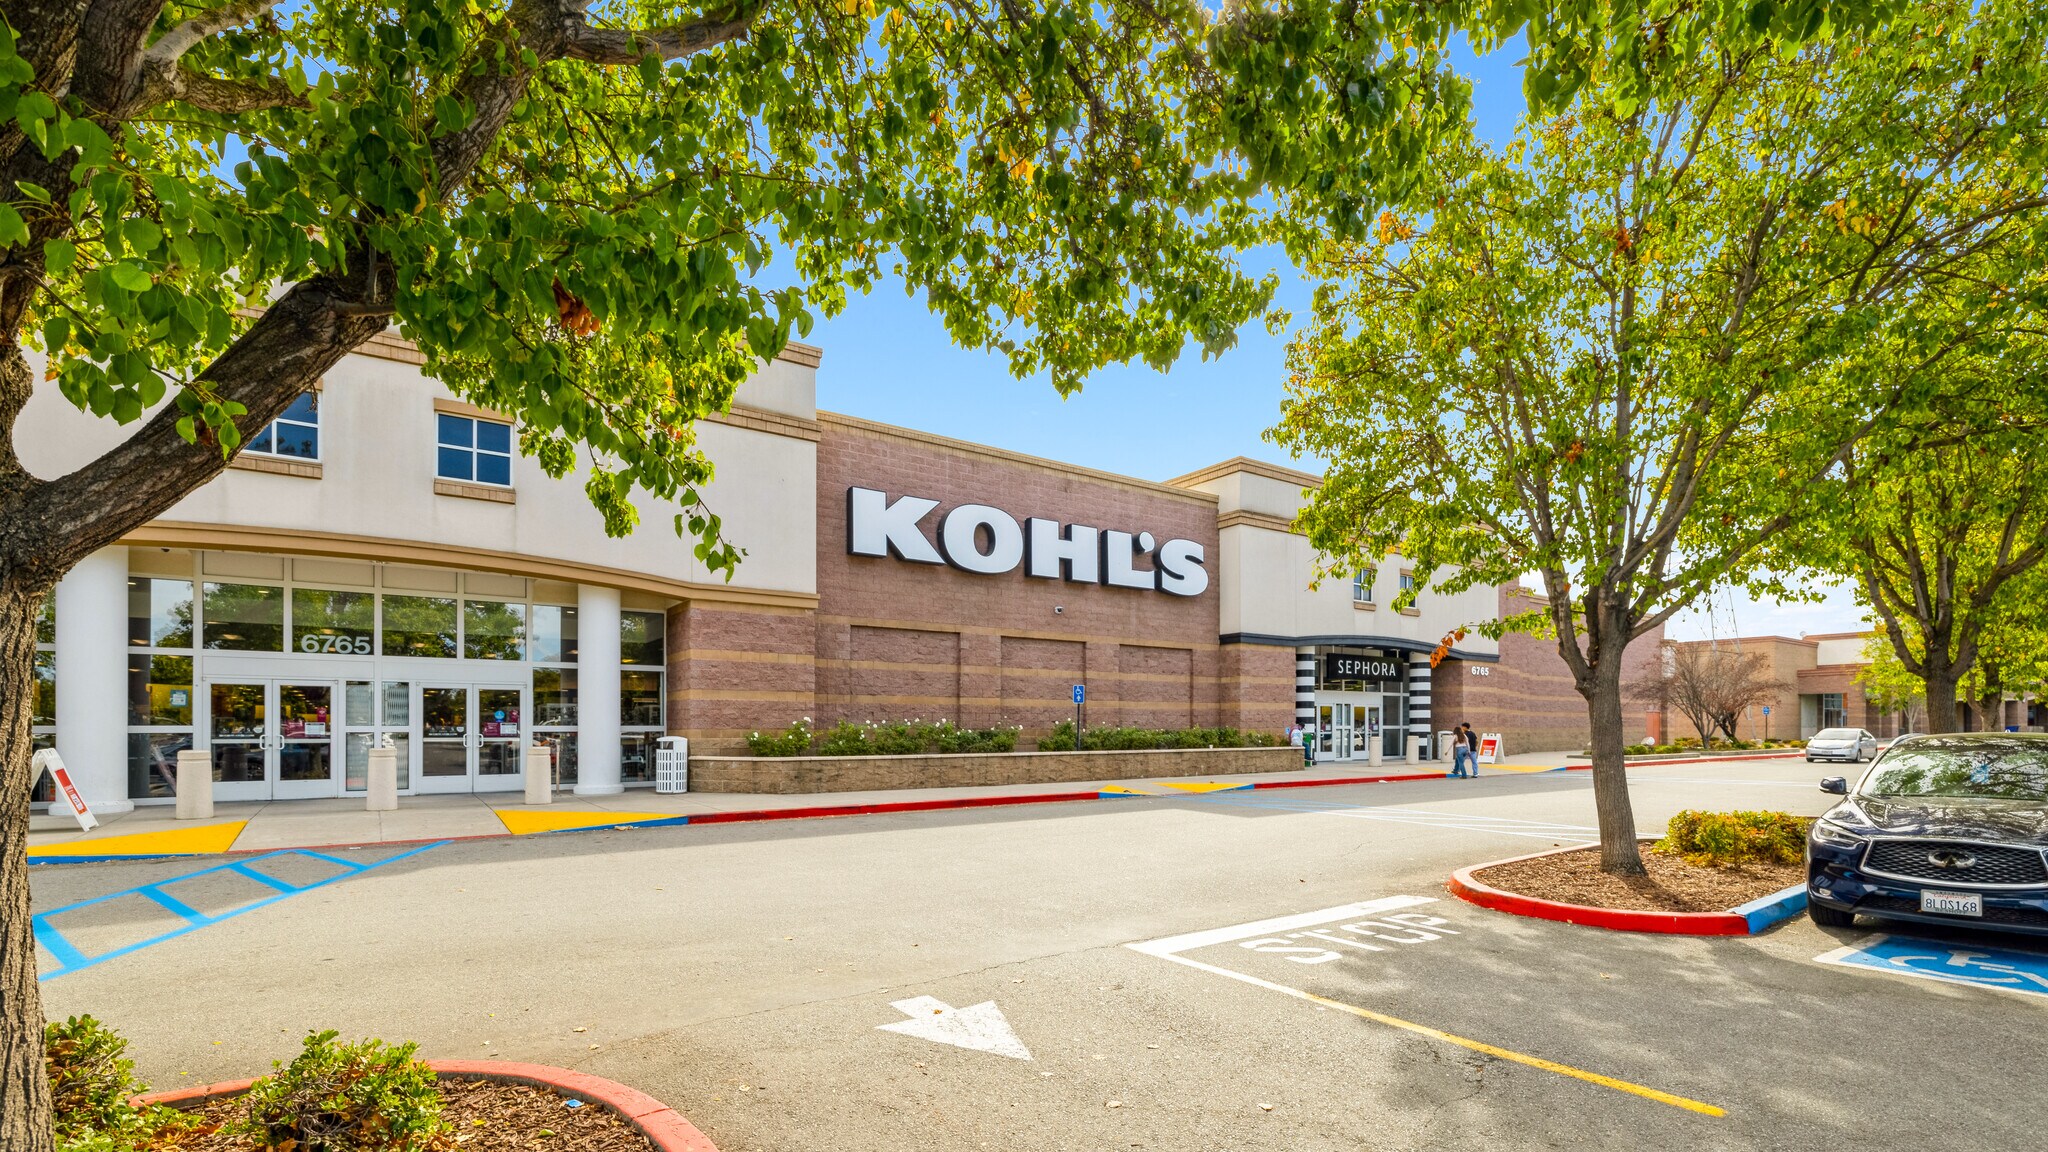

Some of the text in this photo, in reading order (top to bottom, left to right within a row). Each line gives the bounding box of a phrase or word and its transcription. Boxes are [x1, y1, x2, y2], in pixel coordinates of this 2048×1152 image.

[847, 486, 1209, 597] KOHL'S
[301, 634, 371, 655] 6765
[1338, 659, 1396, 677] SEPHORA
[1471, 666, 1489, 677] 6765
[1238, 913, 1462, 964] STOP
